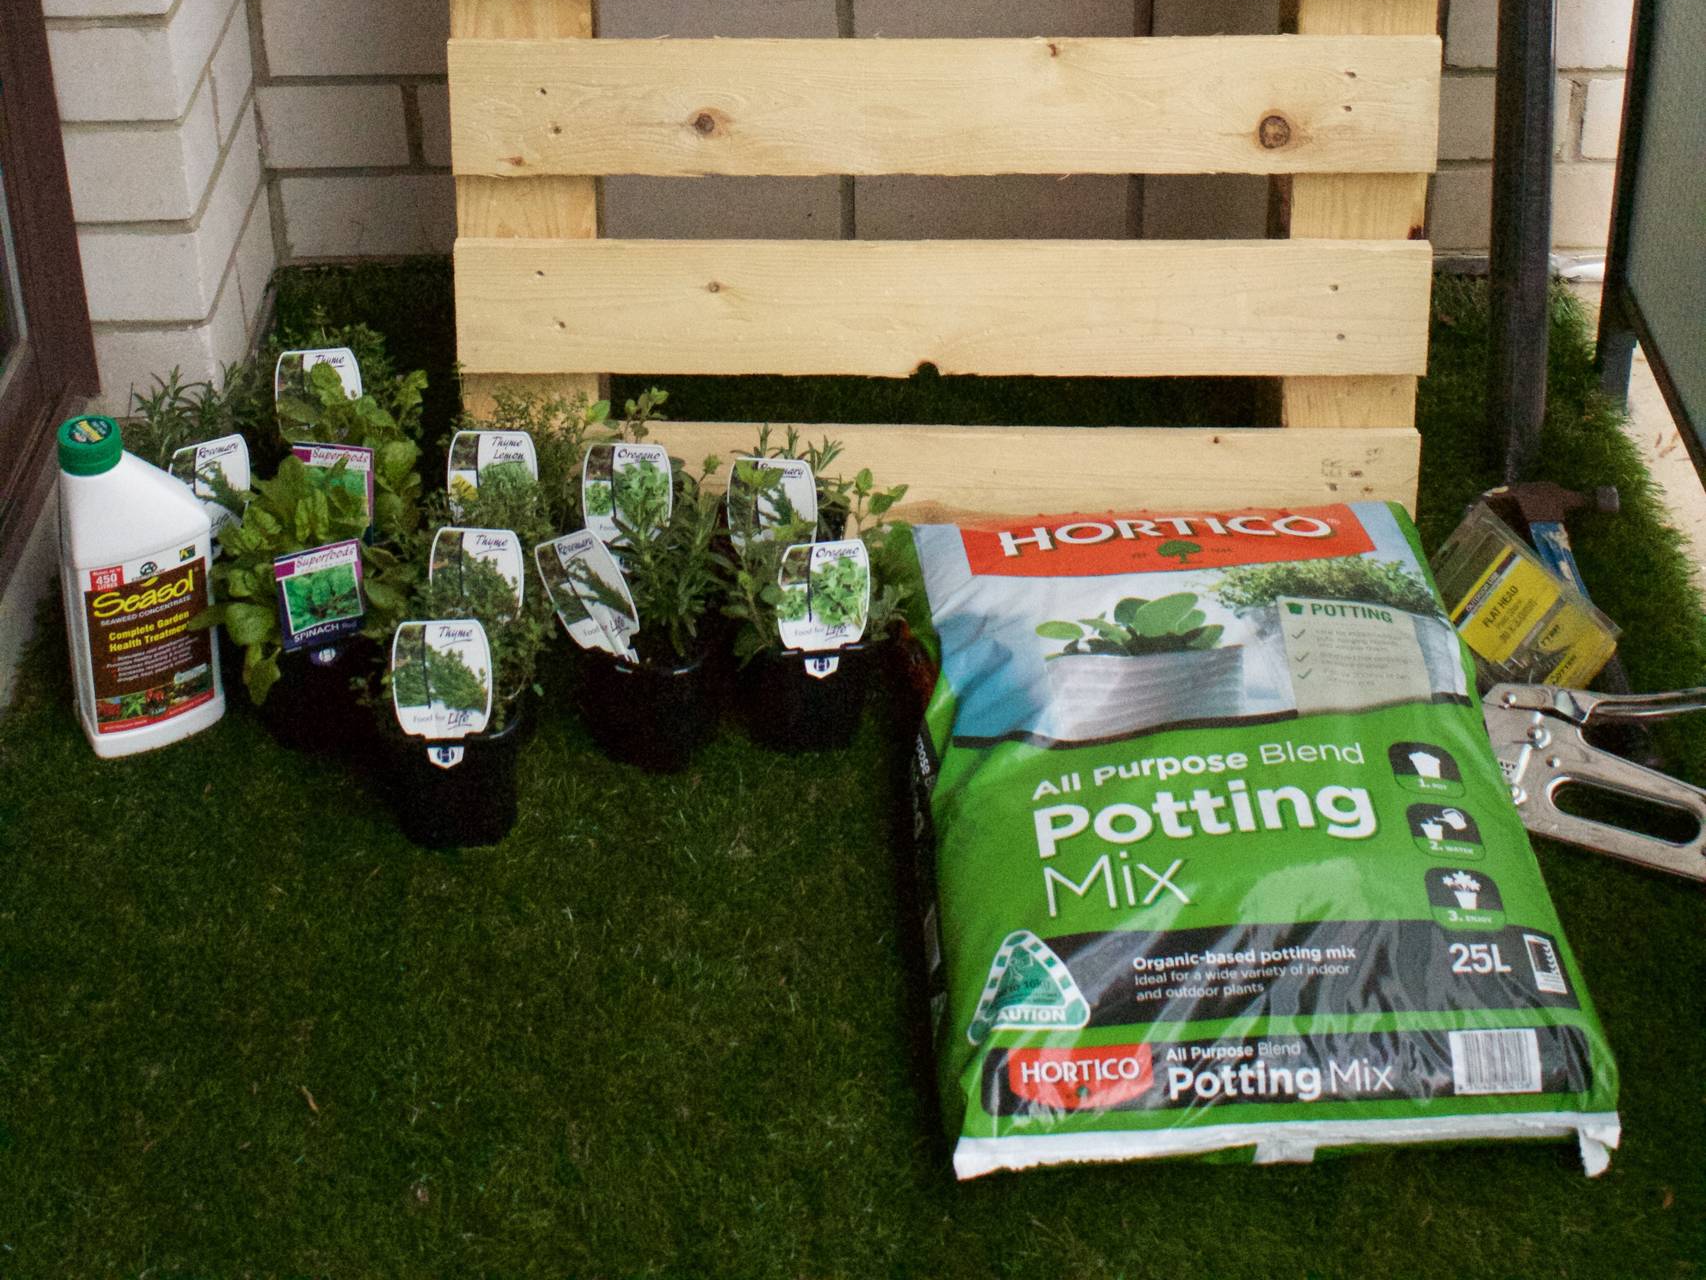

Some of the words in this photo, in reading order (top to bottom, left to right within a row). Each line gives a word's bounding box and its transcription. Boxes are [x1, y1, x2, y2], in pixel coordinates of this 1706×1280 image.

[491, 436, 523, 450] Thyme
[493, 451, 525, 461] Lemon
[617, 448, 660, 463] Oregano
[475, 534, 508, 549] Thyme
[998, 514, 1334, 558] HORTICO
[295, 545, 356, 569] Superfoods
[815, 547, 860, 560] Oregano
[96, 573, 118, 585] 450
[92, 569, 195, 618] Seasol
[1498, 584, 1520, 609] HEAD
[1310, 602, 1394, 624] POTTING
[108, 622, 155, 641] Complete
[157, 610, 190, 629] Garden
[293, 622, 340, 643] SPINACH
[439, 625, 473, 640] Thyme
[109, 637, 142, 653] Health
[144, 623, 190, 643] Treatmen
[1032, 773, 1082, 801] All
[1093, 751, 1249, 787] Purpose
[1259, 741, 1366, 766] Blend
[1033, 779, 1378, 860] Potting
[1043, 850, 1192, 919] Mix
[1132, 947, 1256, 971] Organic-based
[1260, 945, 1322, 964] potting
[1326, 944, 1357, 960] mix
[1448, 942, 1513, 975] 25L
[1134, 973, 1168, 987] Ideal
[1170, 971, 1191, 984] for
[1193, 973, 1202, 982] a
[1205, 967, 1237, 981] wide
[1240, 965, 1287, 982] variety
[1290, 965, 1304, 976] of
[1306, 963, 1351, 976] indoor
[1136, 988, 1162, 1003] and
[1165, 983, 1219, 999] outdoor
[1222, 980, 1265, 998] plants
[1166, 1045, 1187, 1062] All
[1190, 1044, 1254, 1061] Purpose
[1257, 1040, 1300, 1057] Blend
[1020, 1057, 1140, 1085] HORTICO
[1167, 1059, 1322, 1101] Potting
[1328, 1058, 1395, 1093] Mix
